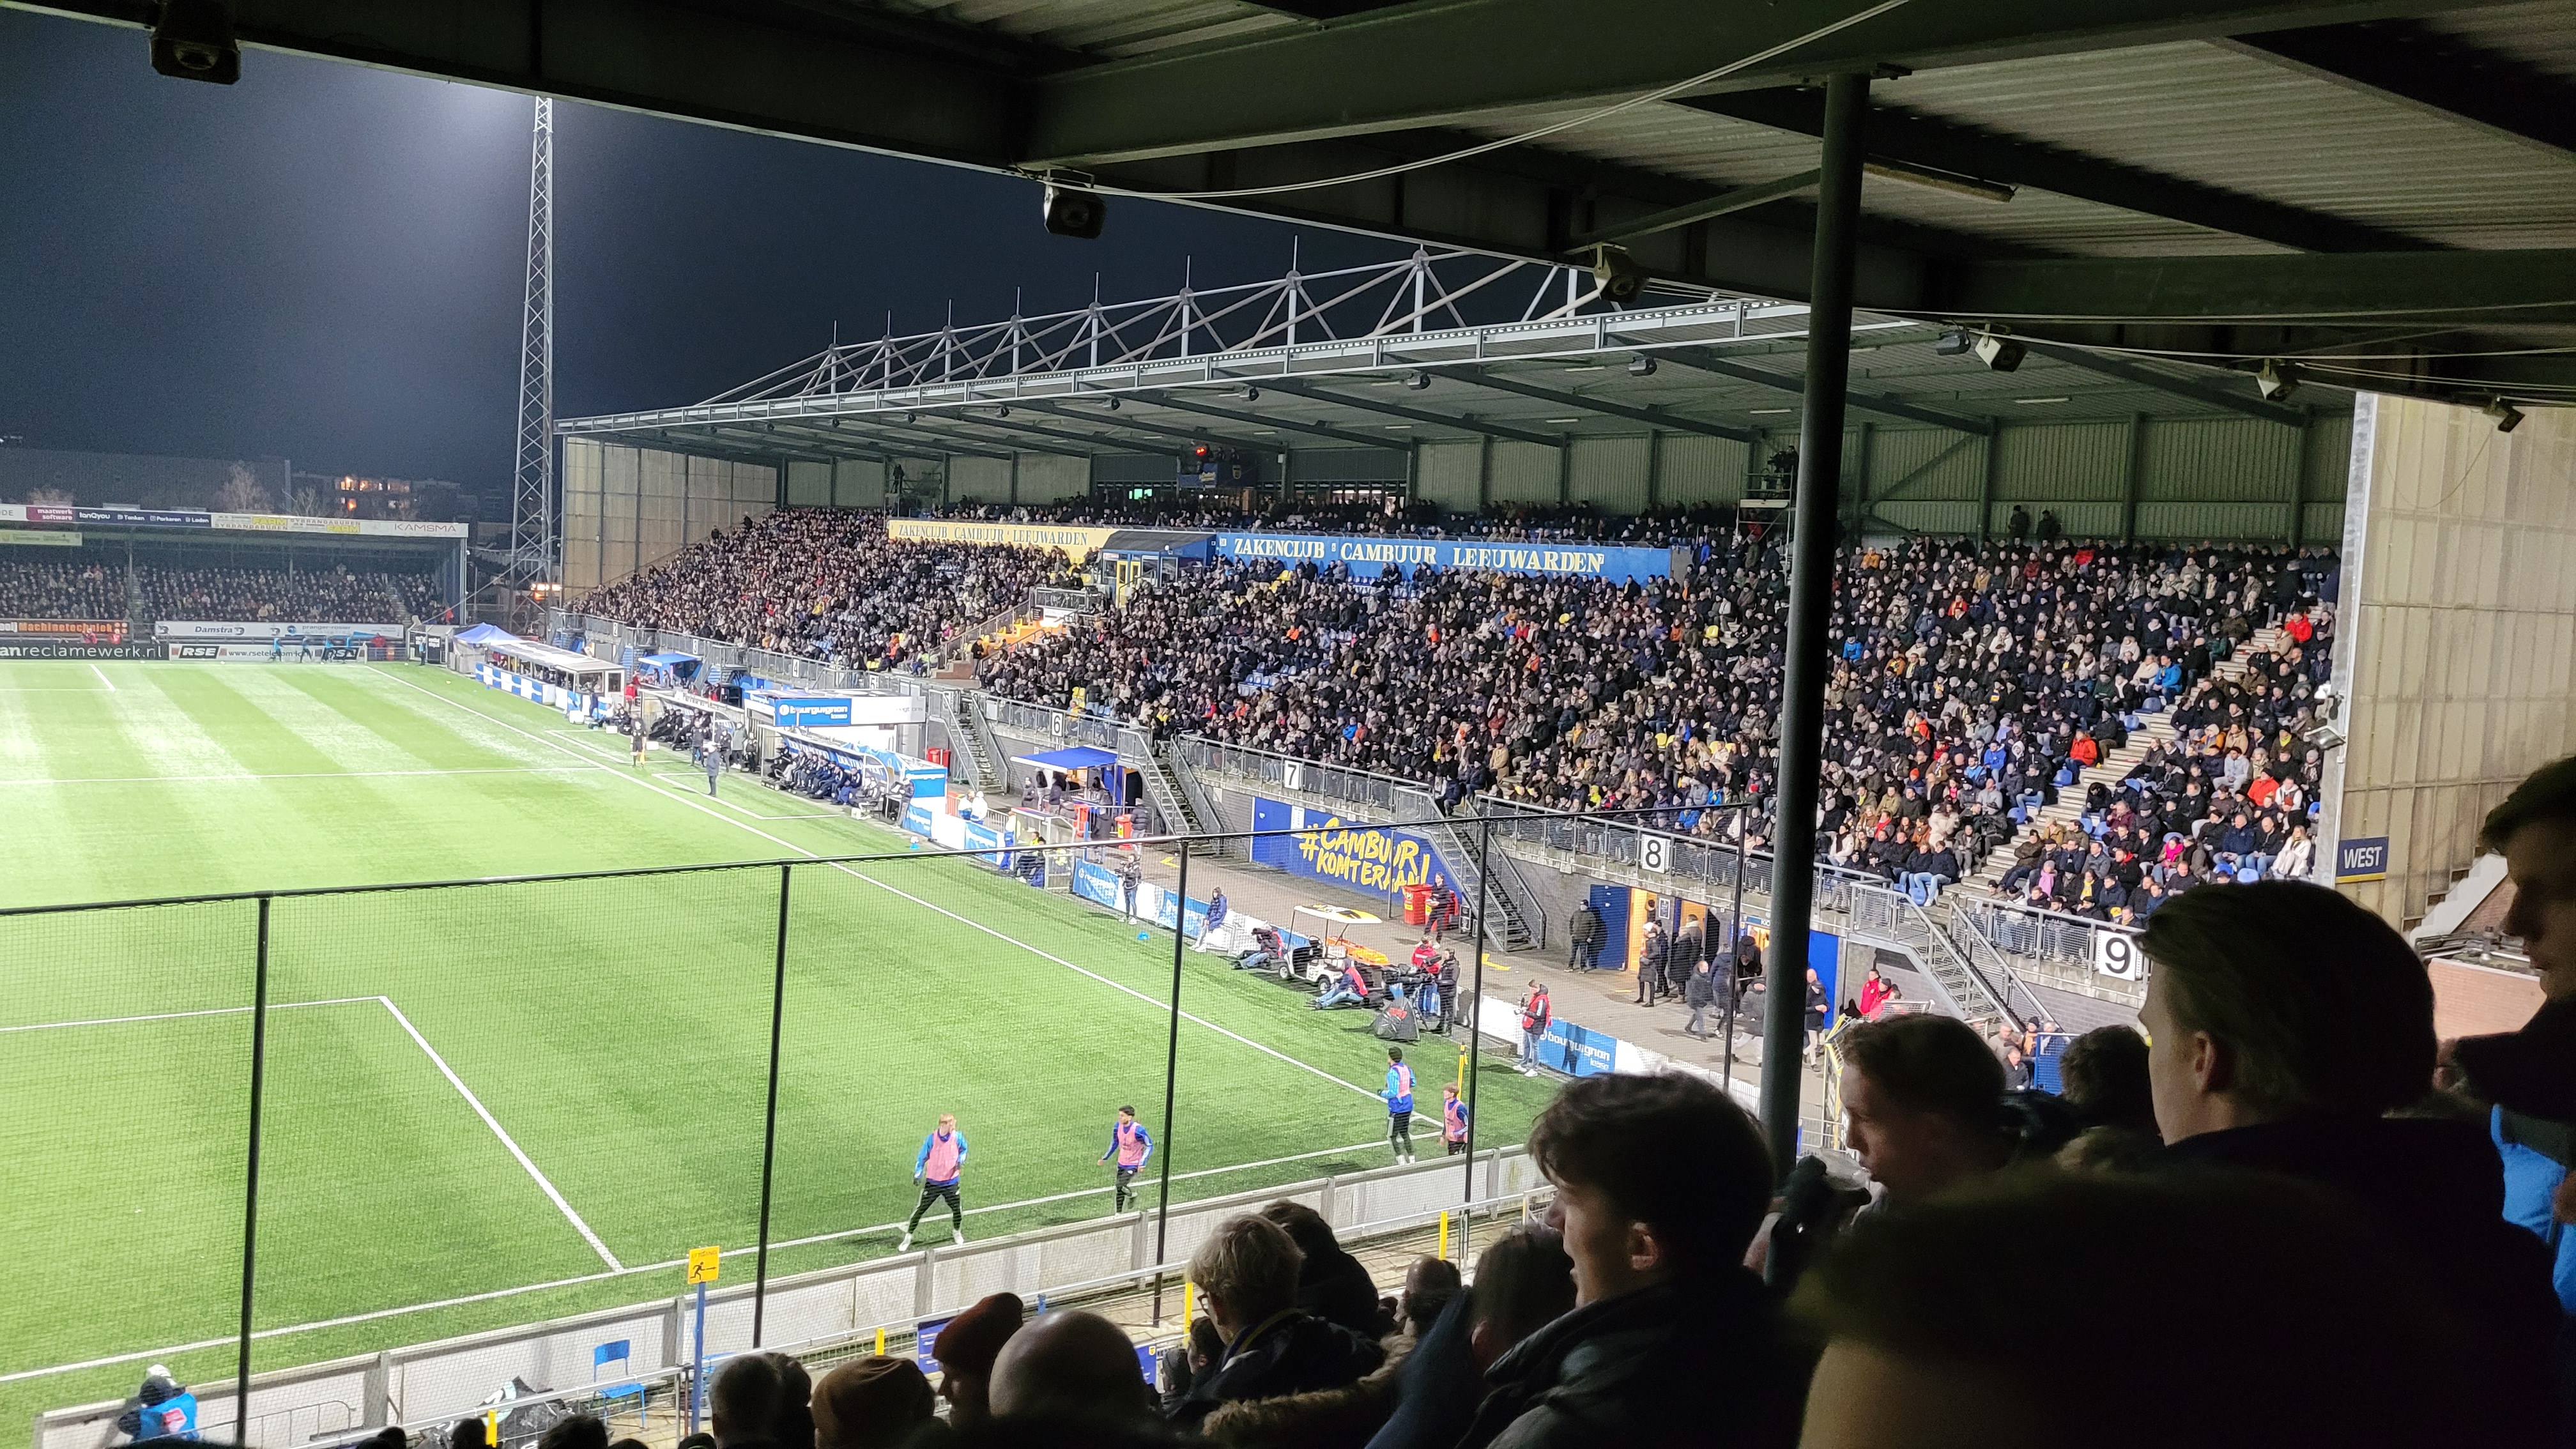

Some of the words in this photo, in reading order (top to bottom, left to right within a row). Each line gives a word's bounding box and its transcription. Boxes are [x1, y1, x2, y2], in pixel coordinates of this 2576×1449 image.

[395, 523, 456, 532] KAMSMA
[899, 525, 947, 538] ZAKENCLUB
[954, 527, 1004, 541] CAMBUUR
[1013, 530, 1087, 546] LEEUWARDEN
[1234, 538, 1324, 558] ZAKENCLUB
[1340, 542, 1437, 564] CAMBUUR
[1453, 548, 1600, 572] LEEUWARDEN
[183, 648, 216, 656] RSE
[1054, 716, 1061, 733] 6
[1287, 763, 1297, 786] 7
[1646, 839, 1661, 868] 8
[2344, 847, 2382, 870] WEST
[2105, 937, 2131, 974] 9
[1547, 1031, 1610, 1061] bouguignon
